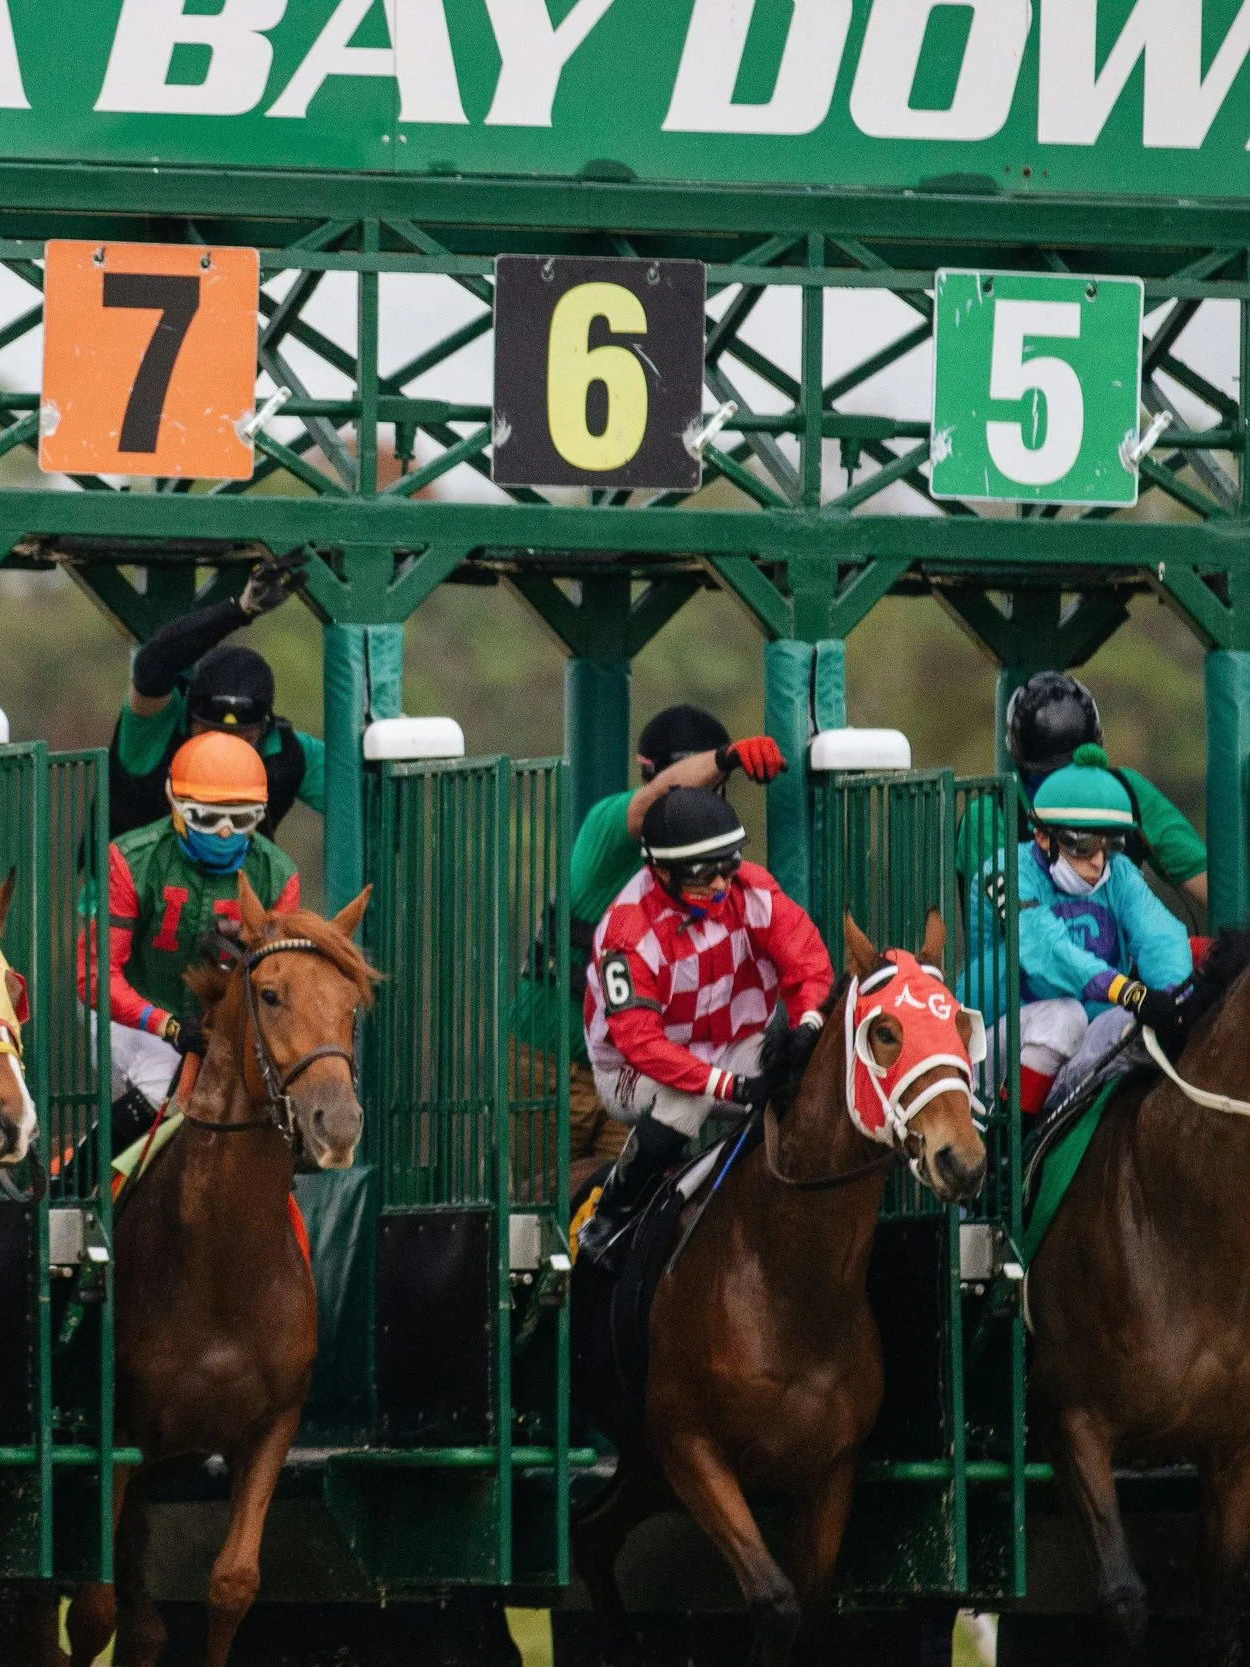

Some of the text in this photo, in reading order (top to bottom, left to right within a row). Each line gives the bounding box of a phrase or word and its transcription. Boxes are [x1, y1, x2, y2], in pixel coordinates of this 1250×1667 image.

[94, 0, 612, 128] BAY
[661, 0, 1250, 151] DOW
[102, 272, 201, 454] 7
[547, 281, 648, 472] 6
[984, 298, 1084, 486] 5
[606, 961, 630, 1004] 6
